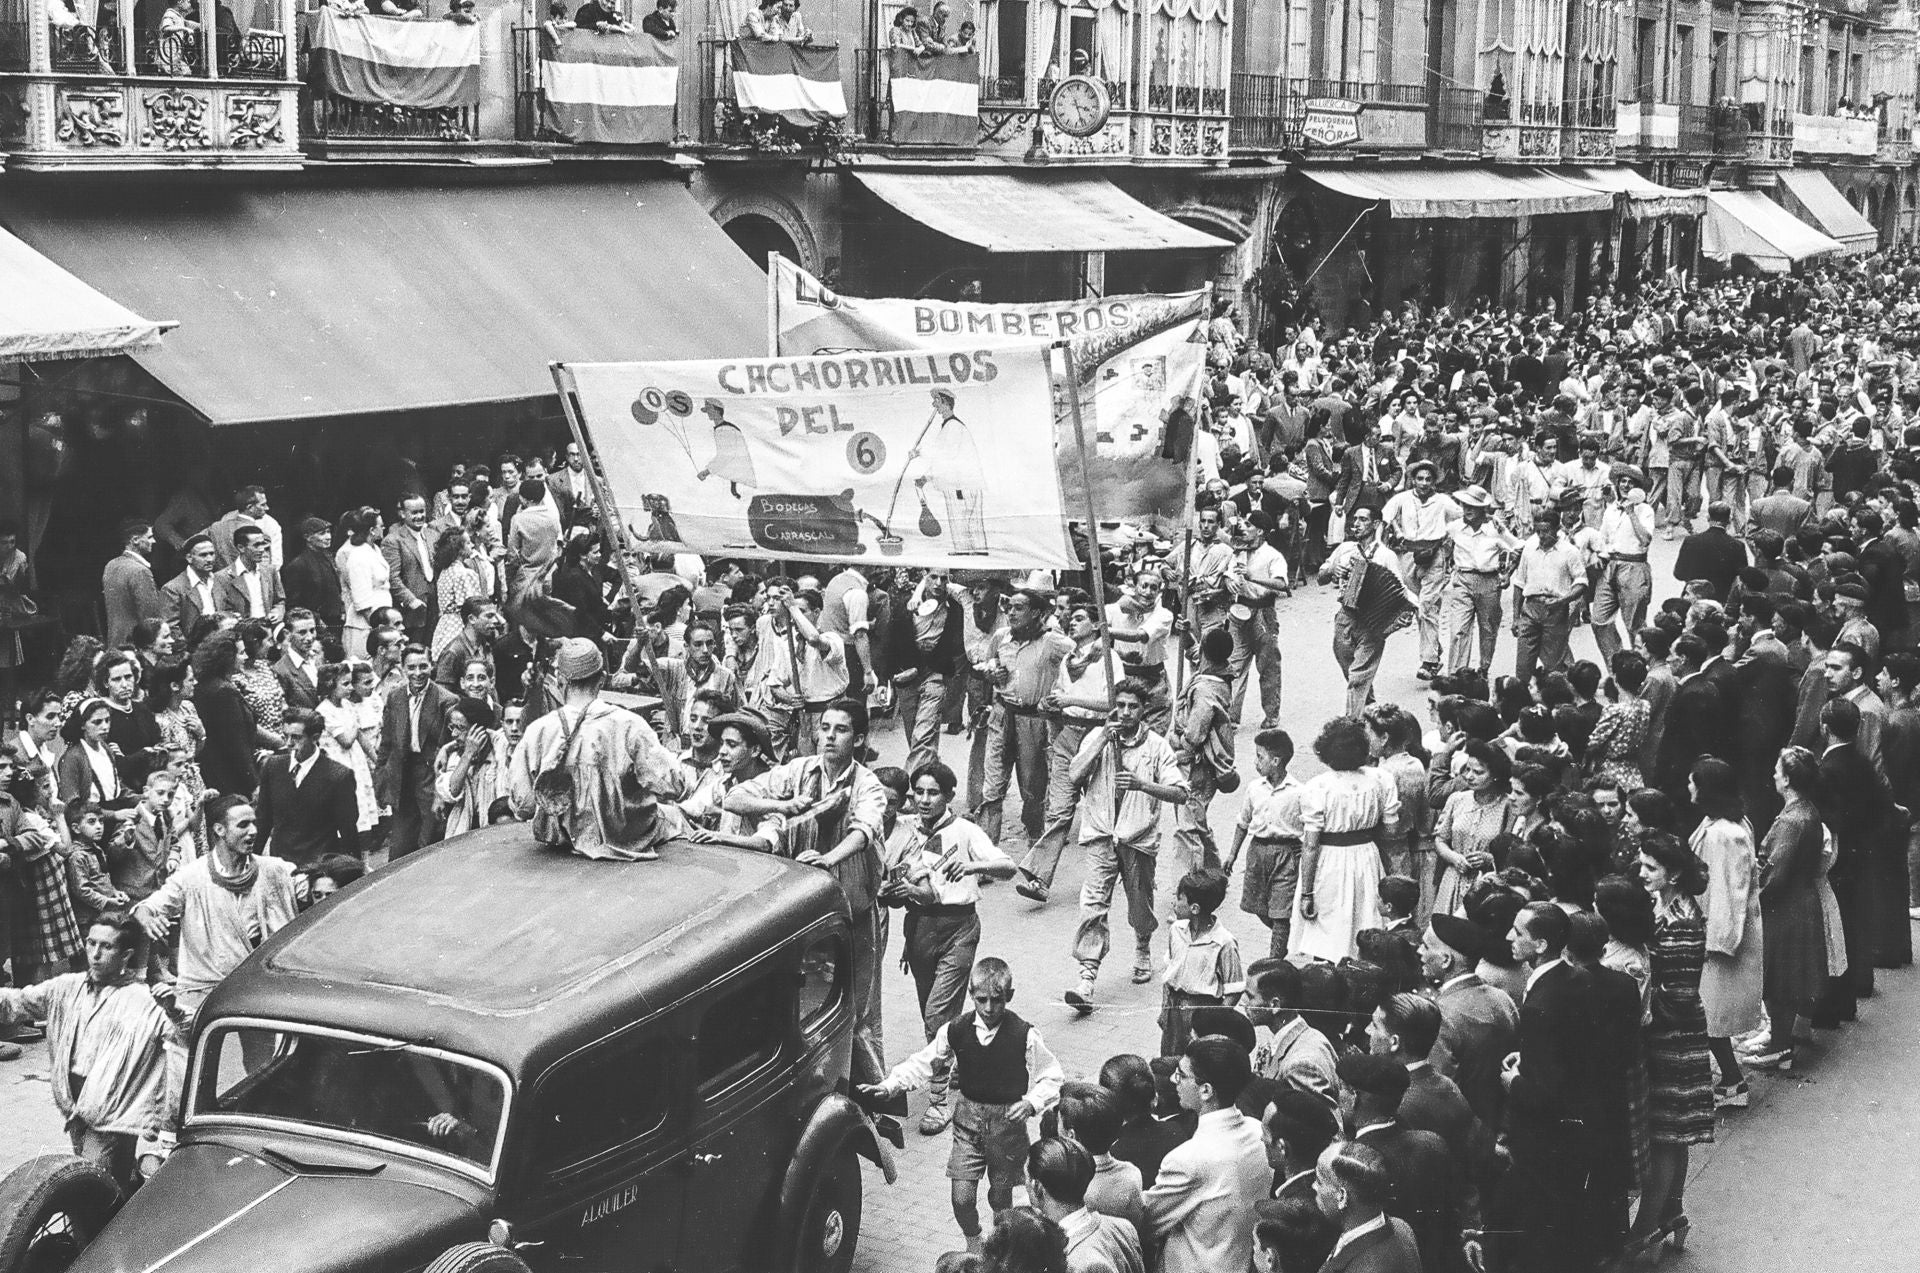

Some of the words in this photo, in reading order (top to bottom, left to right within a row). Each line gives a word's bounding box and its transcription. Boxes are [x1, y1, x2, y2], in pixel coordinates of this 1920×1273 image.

[914, 302, 1133, 337] BOMBEROS
[718, 349, 999, 395] CACHORRILLOS
[776, 404, 855, 437] DEL
[855, 437, 877, 469] 6
[580, 1184, 639, 1228] ALQUILER
